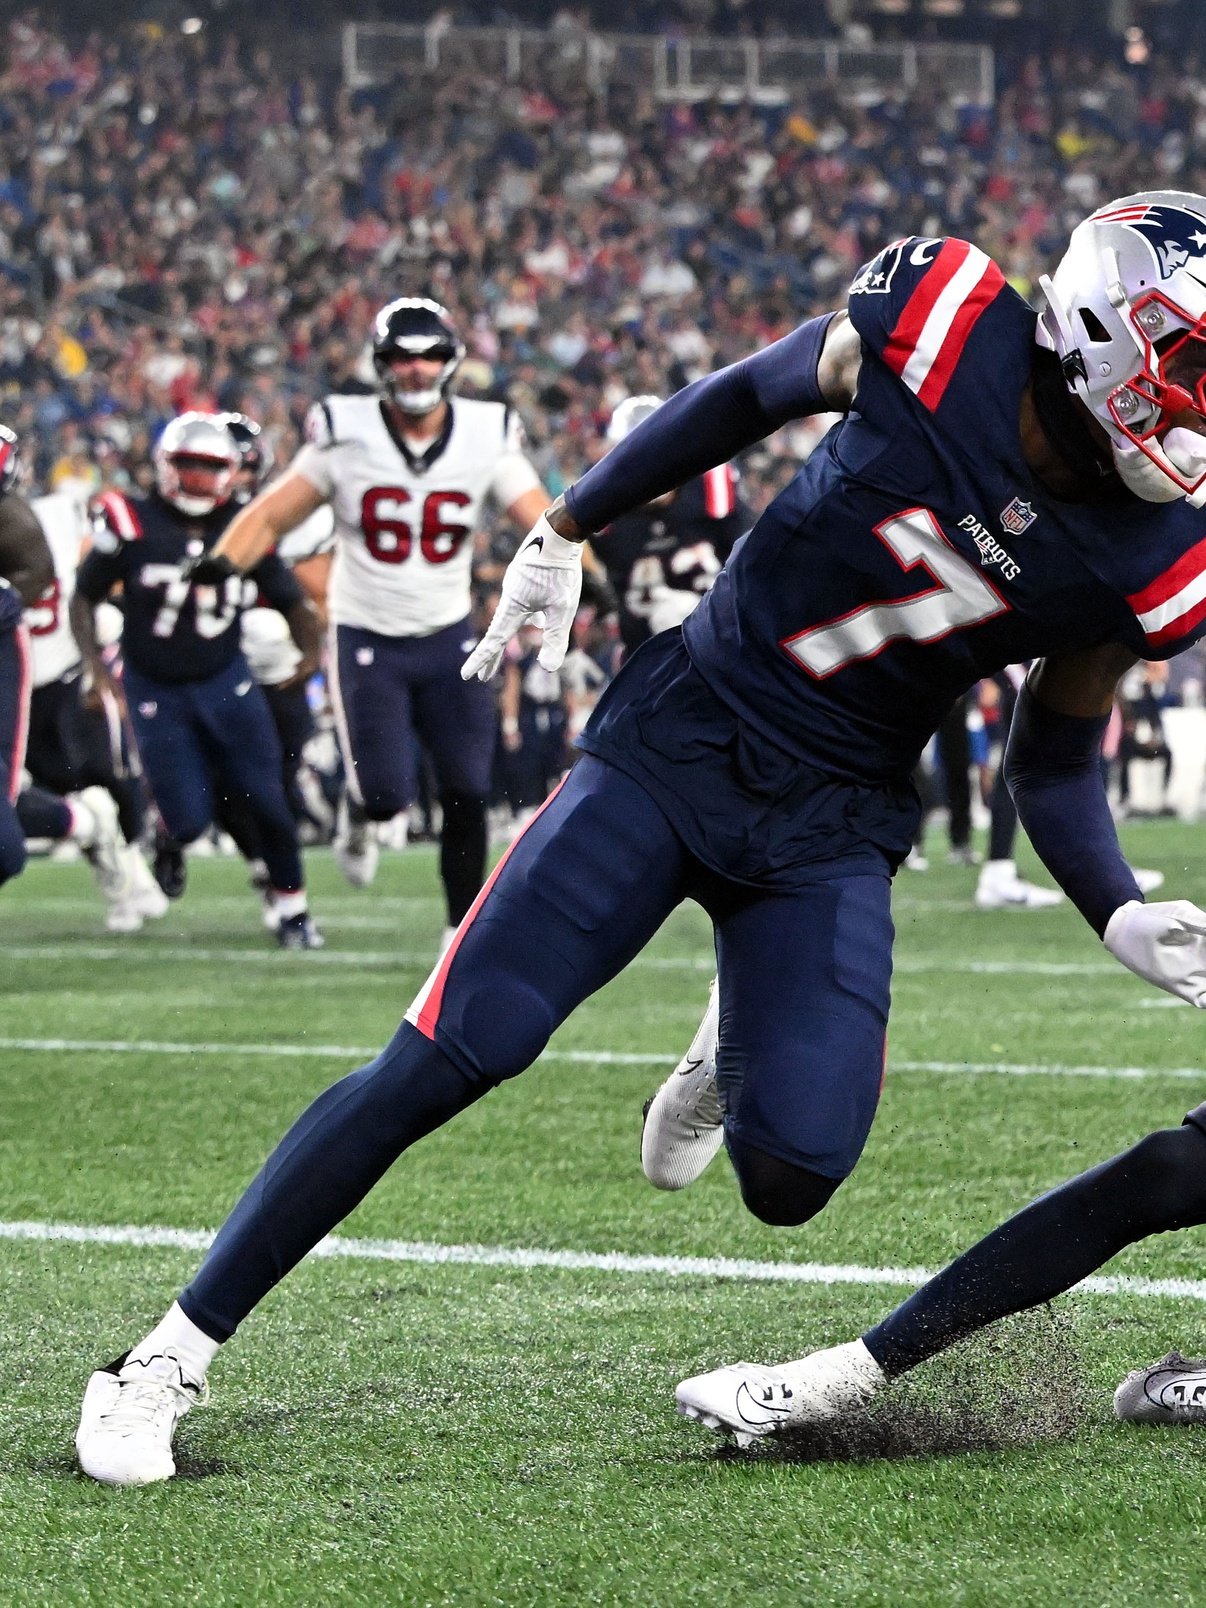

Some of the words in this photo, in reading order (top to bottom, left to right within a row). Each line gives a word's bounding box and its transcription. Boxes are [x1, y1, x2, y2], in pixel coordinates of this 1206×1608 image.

[361, 486, 472, 564] 66
[957, 514, 1021, 580] PATRIOTS
[780, 507, 1012, 680] 7
